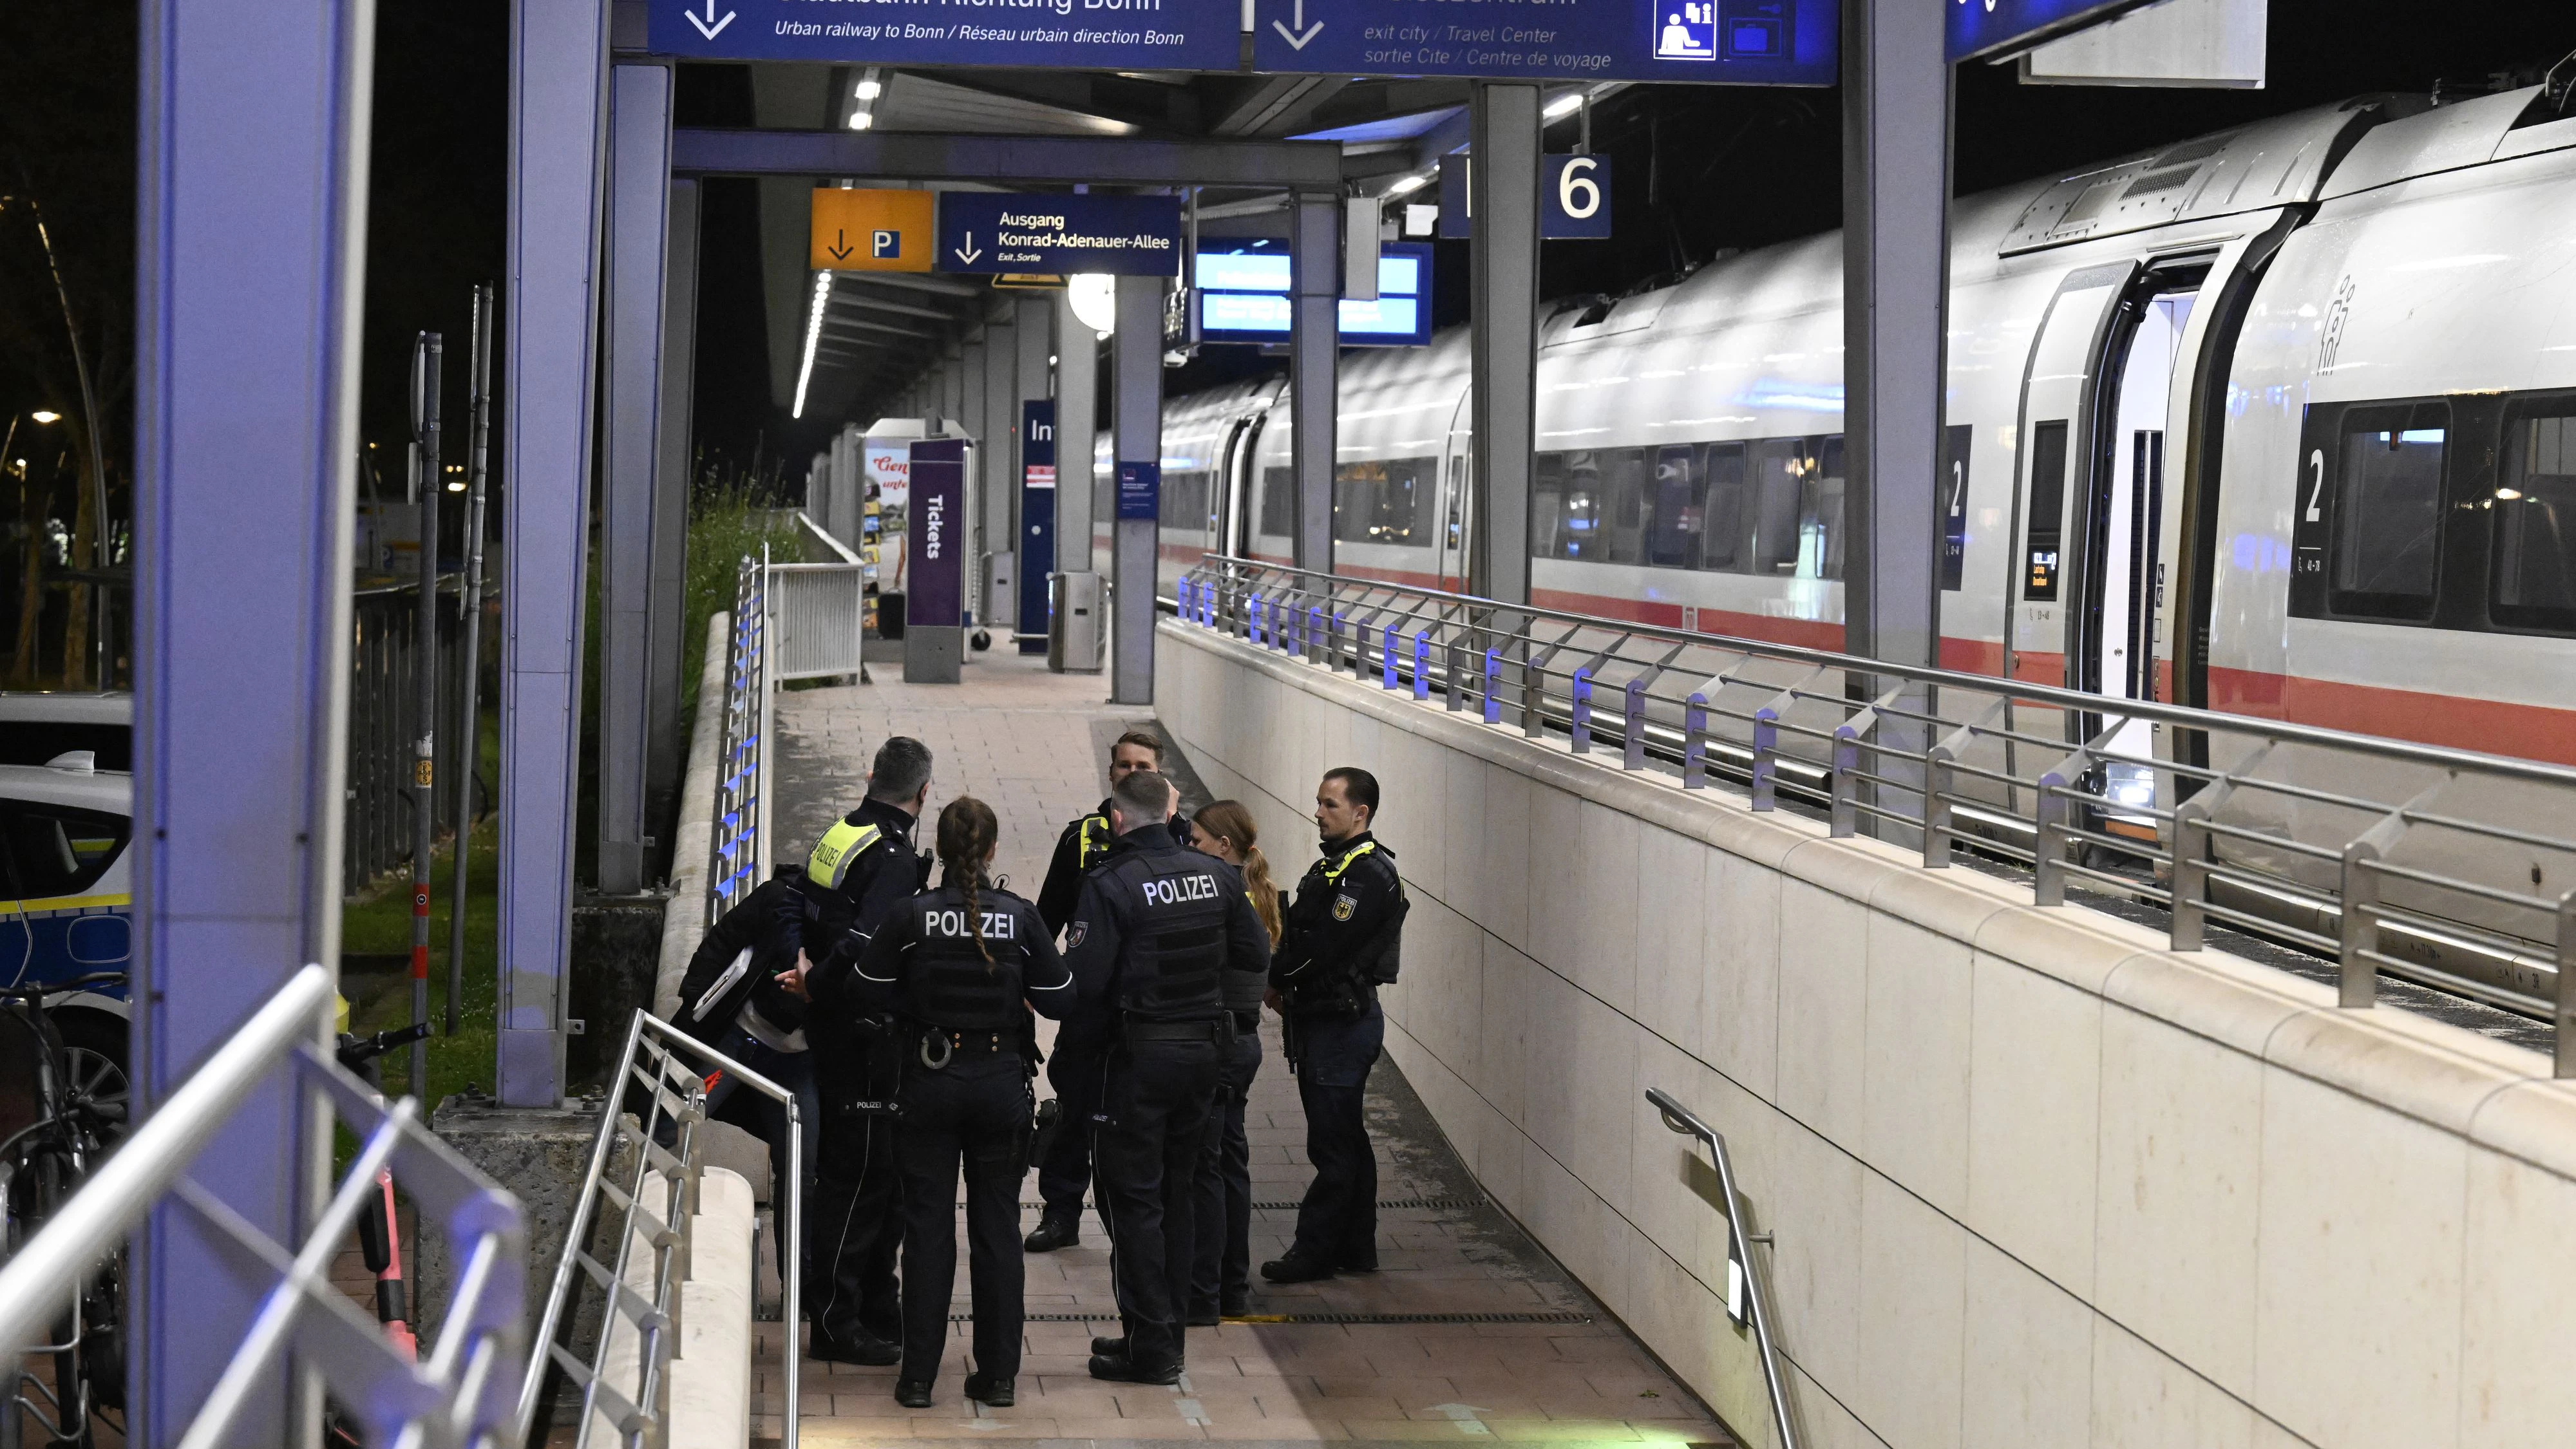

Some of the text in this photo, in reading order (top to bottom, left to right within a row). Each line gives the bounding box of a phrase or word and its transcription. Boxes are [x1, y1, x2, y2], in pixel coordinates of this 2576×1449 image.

[775, 21, 1184, 45] Urban railway to Bonn / Réseau urbain direction Bonn
[1365, 26, 1394, 40] exit
[1399, 26, 1429, 43] city
[1447, 26, 1495, 43] Travel
[1501, 27, 1557, 43] Center
[1365, 48, 1412, 64] sortie
[1467, 50, 1521, 66] Centre
[1528, 52, 1547, 65] de
[1553, 54, 1611, 71] voyage
[1560, 157, 1600, 218] 6
[999, 212, 1065, 230] Ausgang
[874, 231, 892, 257] P
[998, 232, 1170, 249] Konrad-Adenauer-Allee
[1017, 252, 1041, 261] Sortie
[1032, 419, 1056, 441] In
[1951, 460, 1962, 516] 2
[2306, 449, 2324, 522] 2
[927, 495, 943, 559] Tickets
[1142, 875, 1218, 906] POLIZEI
[1339, 895, 1355, 906] POLIZEI
[925, 911, 1014, 939] POLZEI
